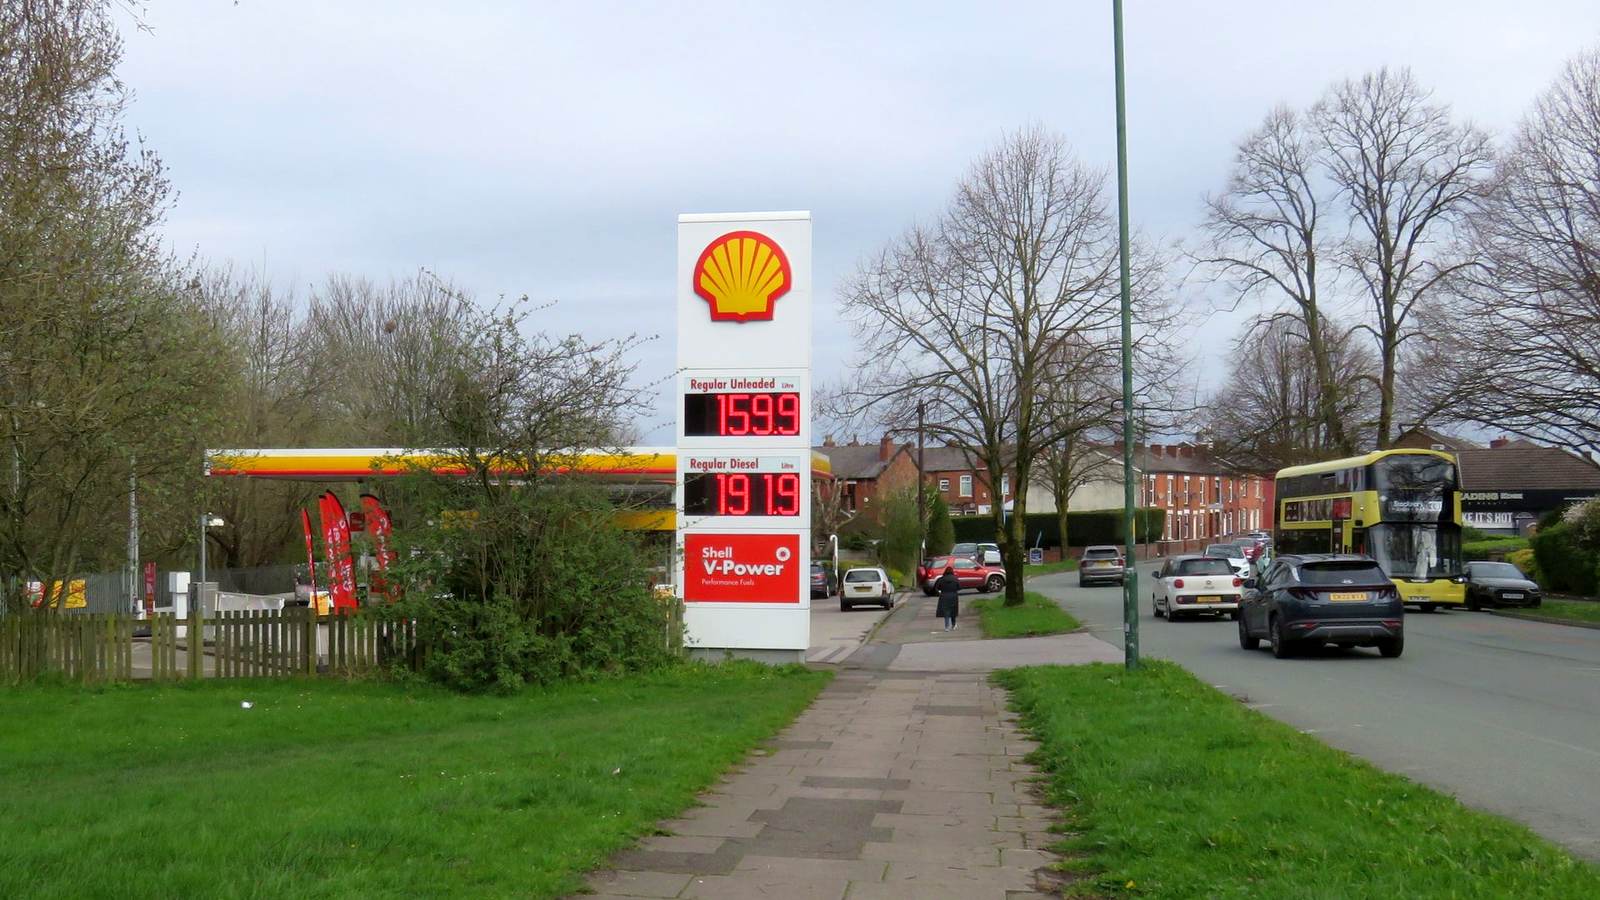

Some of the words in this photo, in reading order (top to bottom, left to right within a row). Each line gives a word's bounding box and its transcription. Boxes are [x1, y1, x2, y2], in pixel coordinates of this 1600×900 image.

[690, 378, 727, 392] Regular
[730, 378, 775, 389] Unleaded
[717, 393, 799, 436] 159.9
[690, 458, 727, 471] Regular
[730, 458, 759, 469] Diesel
[1475, 512, 1493, 523] IT'S
[1494, 512, 1513, 523] HOT
[702, 547, 732, 558] Shell
[703, 560, 784, 576] V-Power
[701, 578, 739, 586] Performance
[740, 578, 755, 586] Fuels
